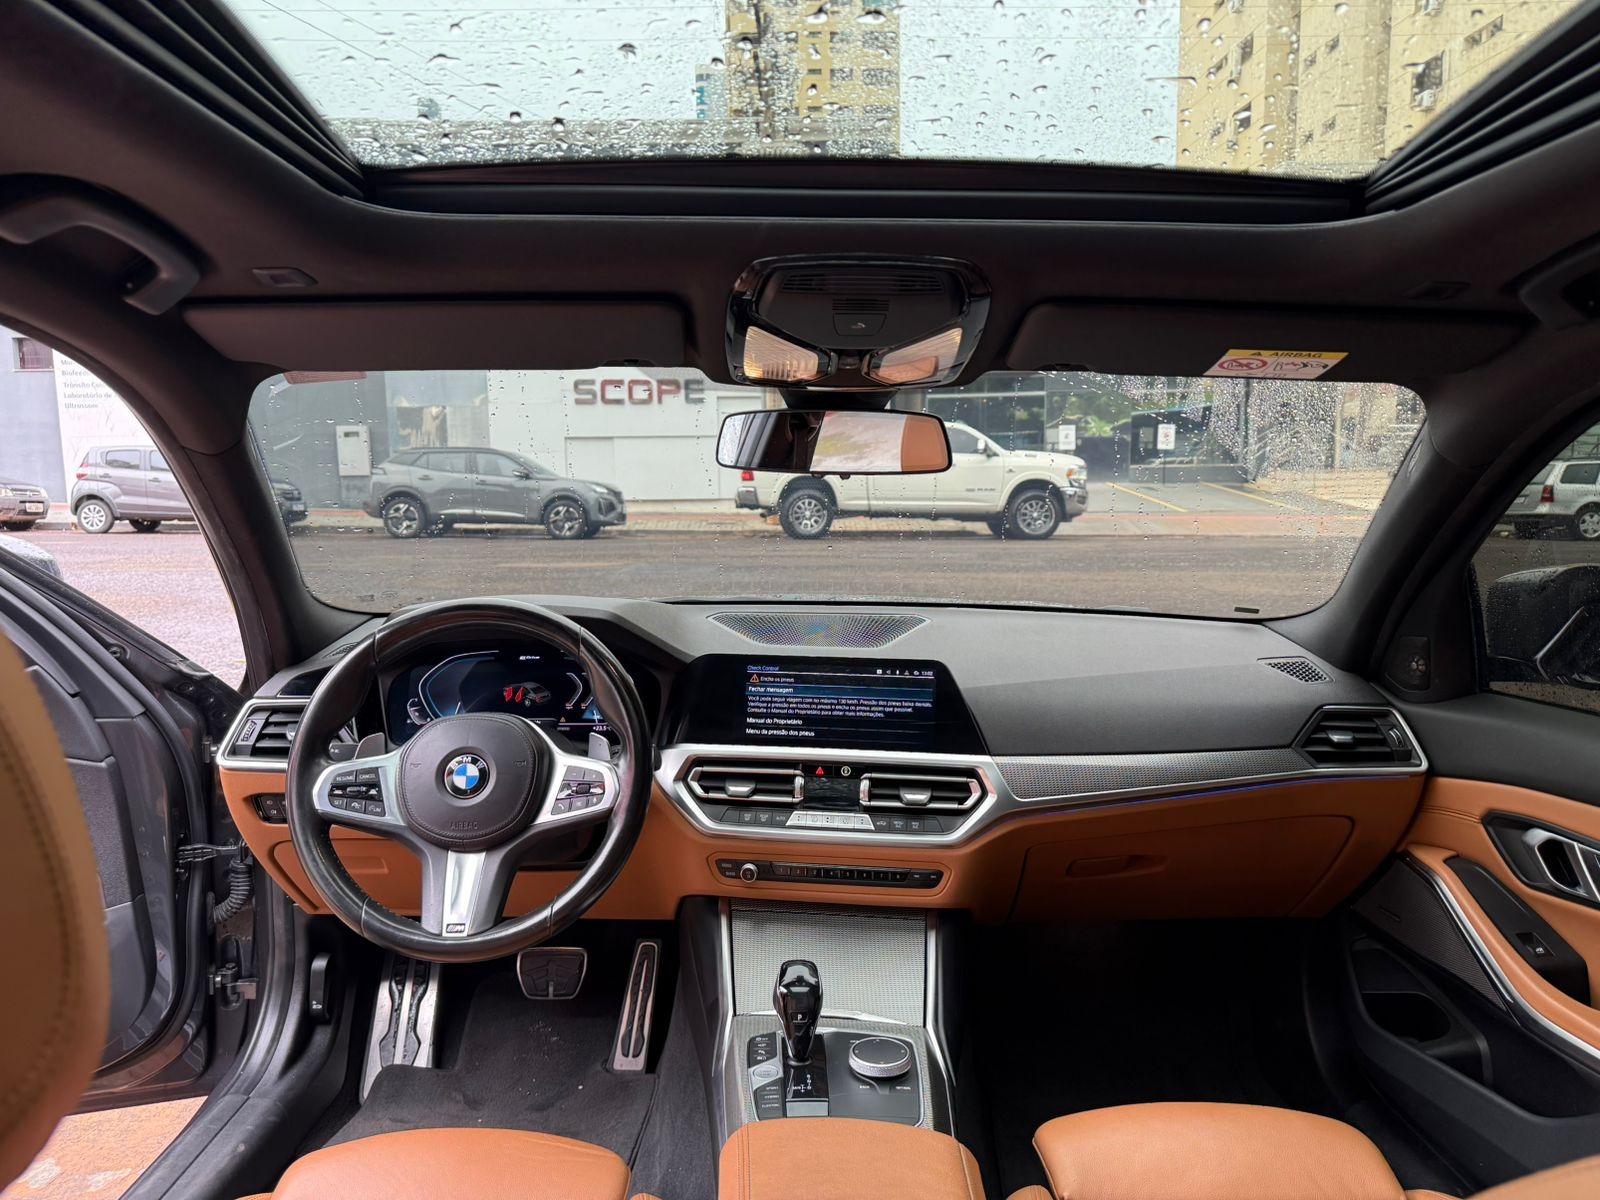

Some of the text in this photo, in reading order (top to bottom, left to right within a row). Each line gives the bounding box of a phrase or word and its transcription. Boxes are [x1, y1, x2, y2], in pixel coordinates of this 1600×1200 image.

[573, 379, 705, 405] SCOPE
[450, 821, 478, 830] AIRBAG
[797, 1013, 803, 1021] P
